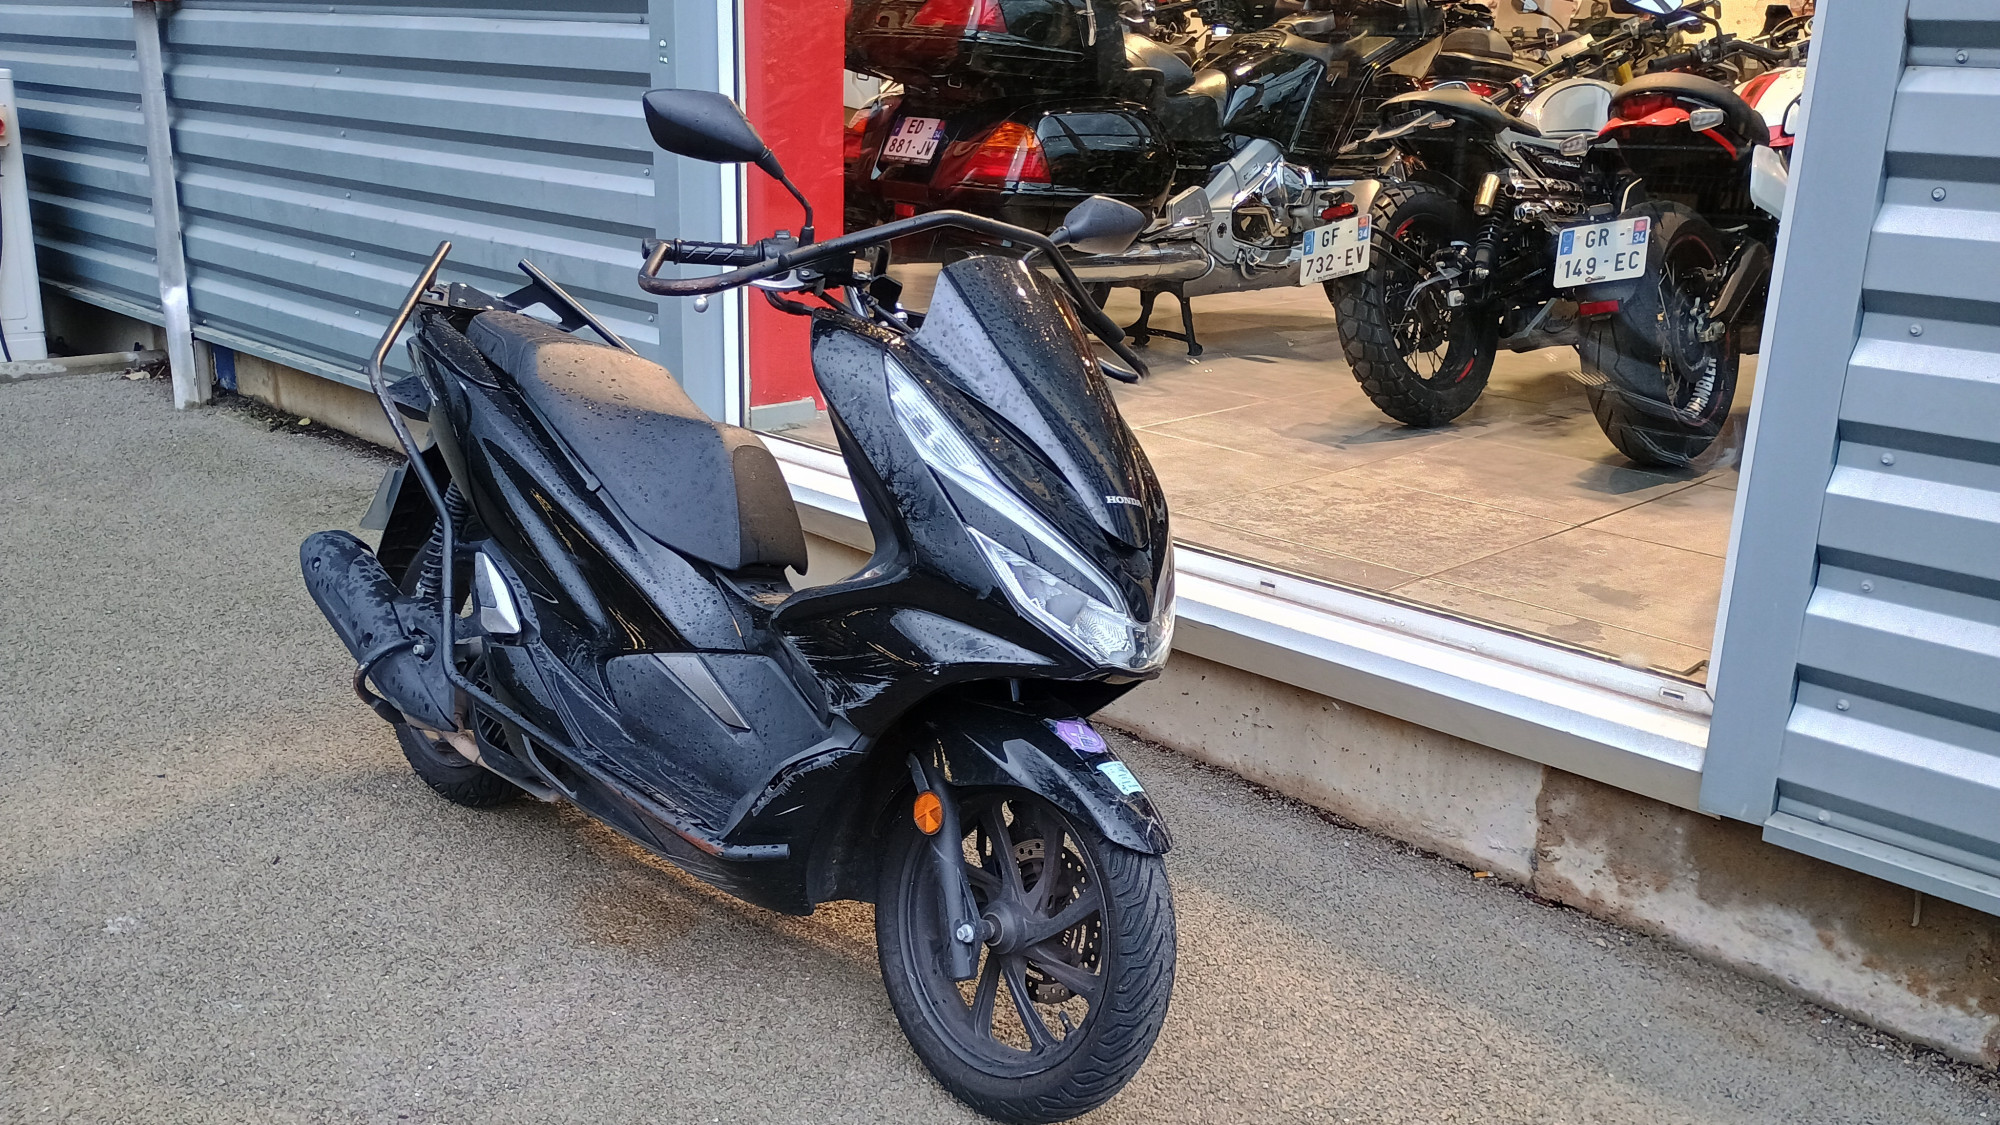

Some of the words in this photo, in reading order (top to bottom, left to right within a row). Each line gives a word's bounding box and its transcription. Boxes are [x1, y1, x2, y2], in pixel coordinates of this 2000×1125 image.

[906, 119, 925, 134] ED
[888, 138, 935, 156] 881-JW
[1321, 227, 1340, 248] GF
[1358, 228, 1368, 239] 34
[1585, 227, 1610, 248] GR
[1305, 245, 1365, 278] 732-EV
[1564, 250, 1640, 279] 149-EC
[1105, 495, 1143, 508] HONDA
